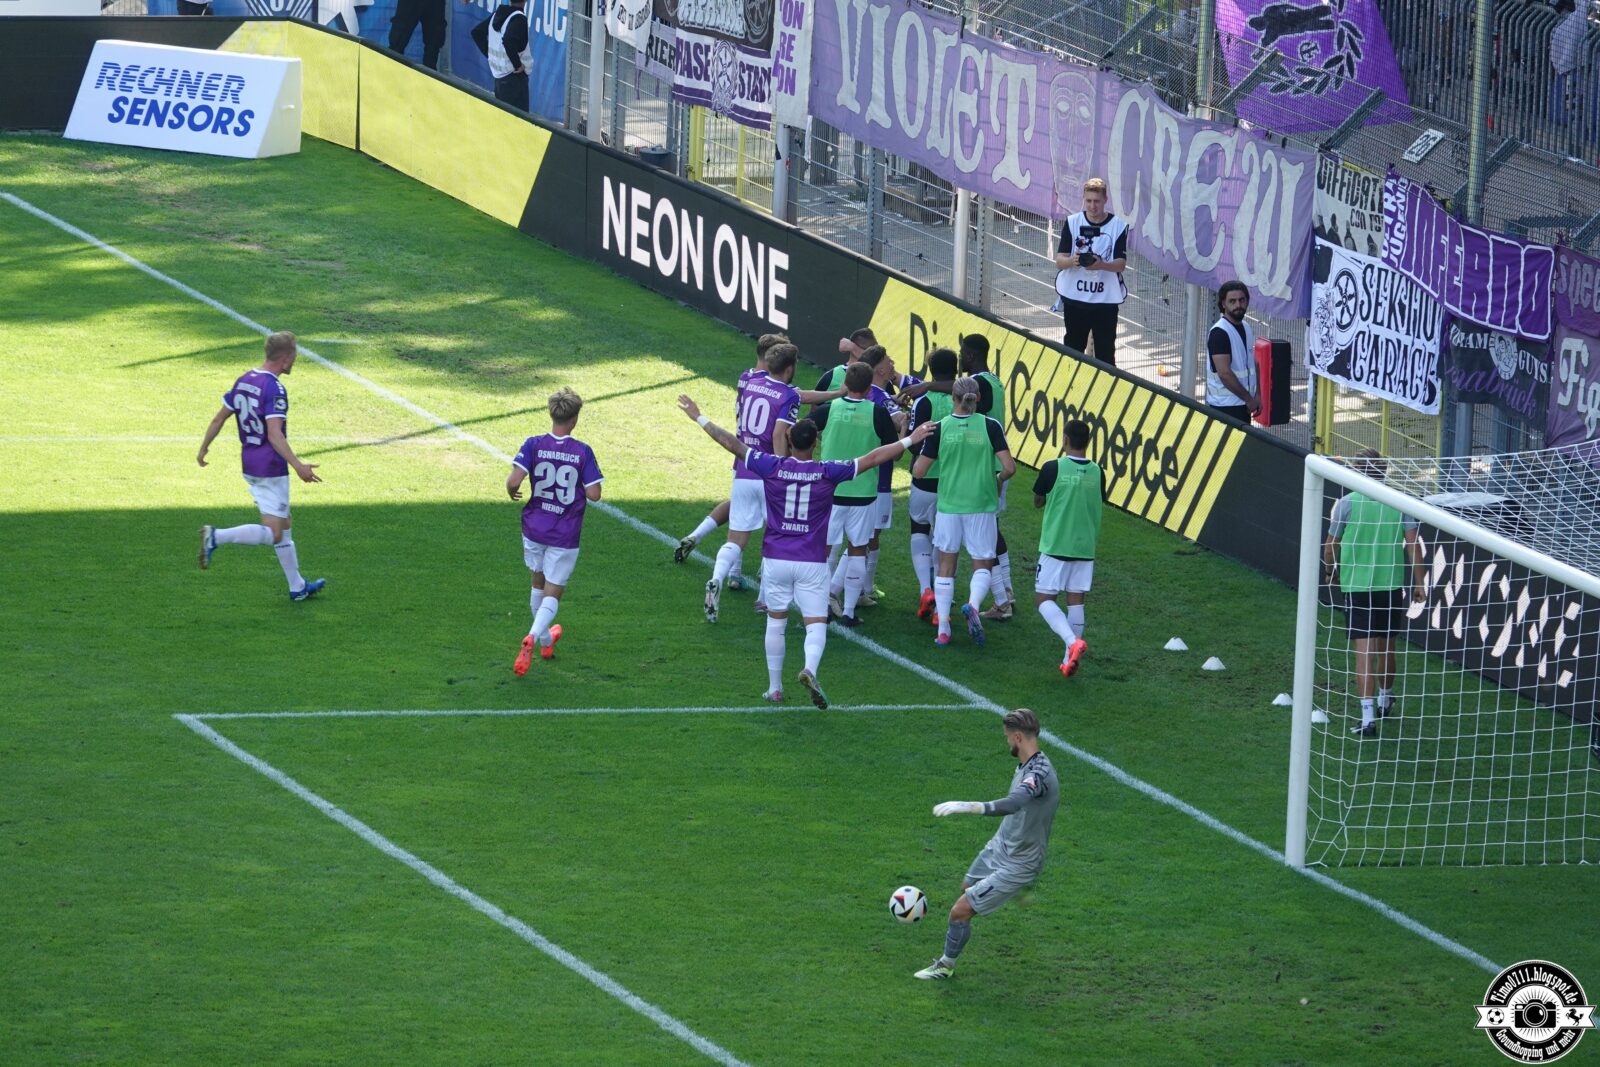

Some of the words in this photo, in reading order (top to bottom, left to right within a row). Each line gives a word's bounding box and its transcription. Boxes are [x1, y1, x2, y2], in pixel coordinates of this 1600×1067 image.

[94, 61, 246, 104] RECHNER
[836, 0, 1037, 191] VIOLET
[107, 95, 255, 137] SENSORS
[603, 176, 704, 291] NEON
[713, 223, 789, 330] ONE
[1076, 279, 1104, 293] CLUB
[1518, 349, 1548, 383] GUYS
[233, 393, 264, 435] 25
[742, 395, 771, 436] 10
[533, 461, 579, 506] 29
[784, 482, 811, 521] 11
[781, 521, 809, 533] ZWARTS
